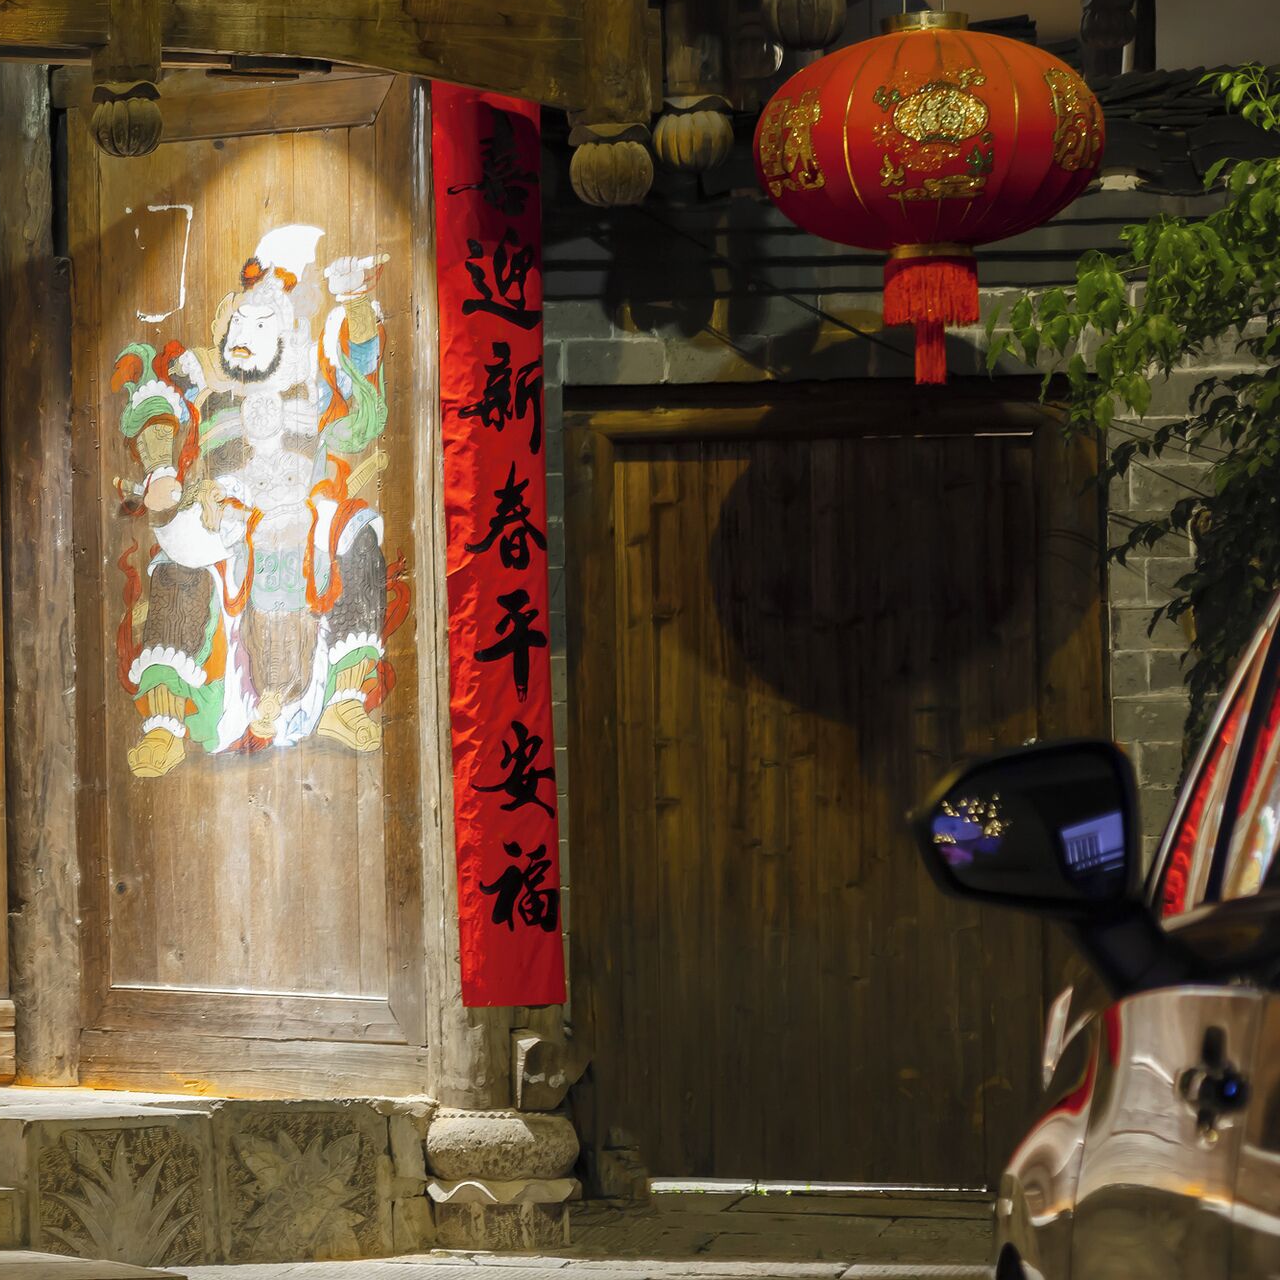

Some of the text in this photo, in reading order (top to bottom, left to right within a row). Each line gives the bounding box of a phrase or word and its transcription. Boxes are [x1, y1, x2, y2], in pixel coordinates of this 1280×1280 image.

[447, 107, 561, 933] 喜迎新春平安福
